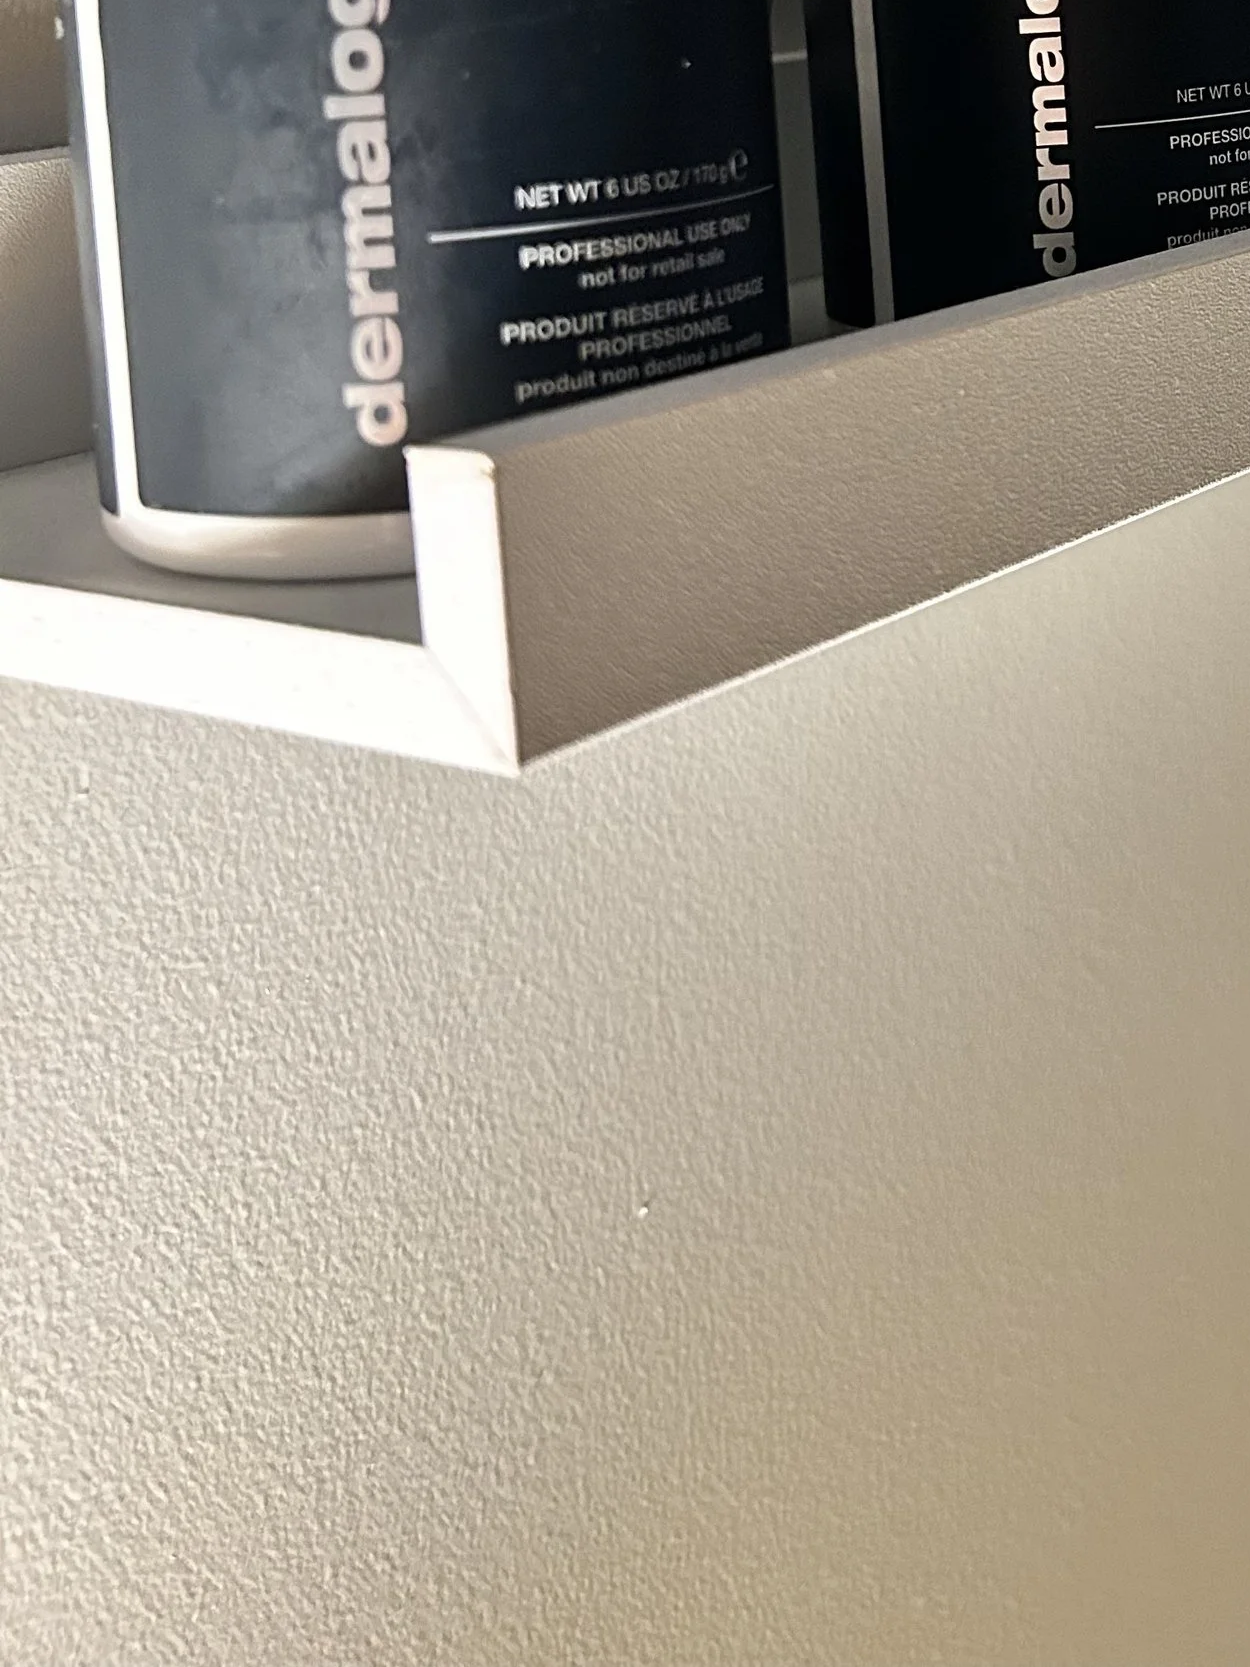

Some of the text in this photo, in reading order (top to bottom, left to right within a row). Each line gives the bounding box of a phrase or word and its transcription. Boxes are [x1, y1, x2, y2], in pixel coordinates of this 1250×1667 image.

[1176, 86, 1206, 104] NET
[1209, 83, 1231, 100] WT
[1233, 82, 1242, 97] 6
[1209, 152, 1233, 166] not
[514, 183, 563, 211] NET
[564, 179, 603, 204] WT
[603, 177, 620, 200] 6
[622, 173, 652, 198] US
[655, 169, 682, 192] OZ
[1156, 183, 1227, 207] PRODUIT
[518, 212, 752, 271] PROFESSIONAL USE ONLY
[577, 269, 616, 290] not
[618, 260, 646, 282] for
[651, 251, 696, 278] retail
[500, 310, 608, 346] PRODUIT
[578, 314, 733, 362] PROFESSIONNEL
[515, 367, 598, 404] produit
[600, 361, 640, 385] non
